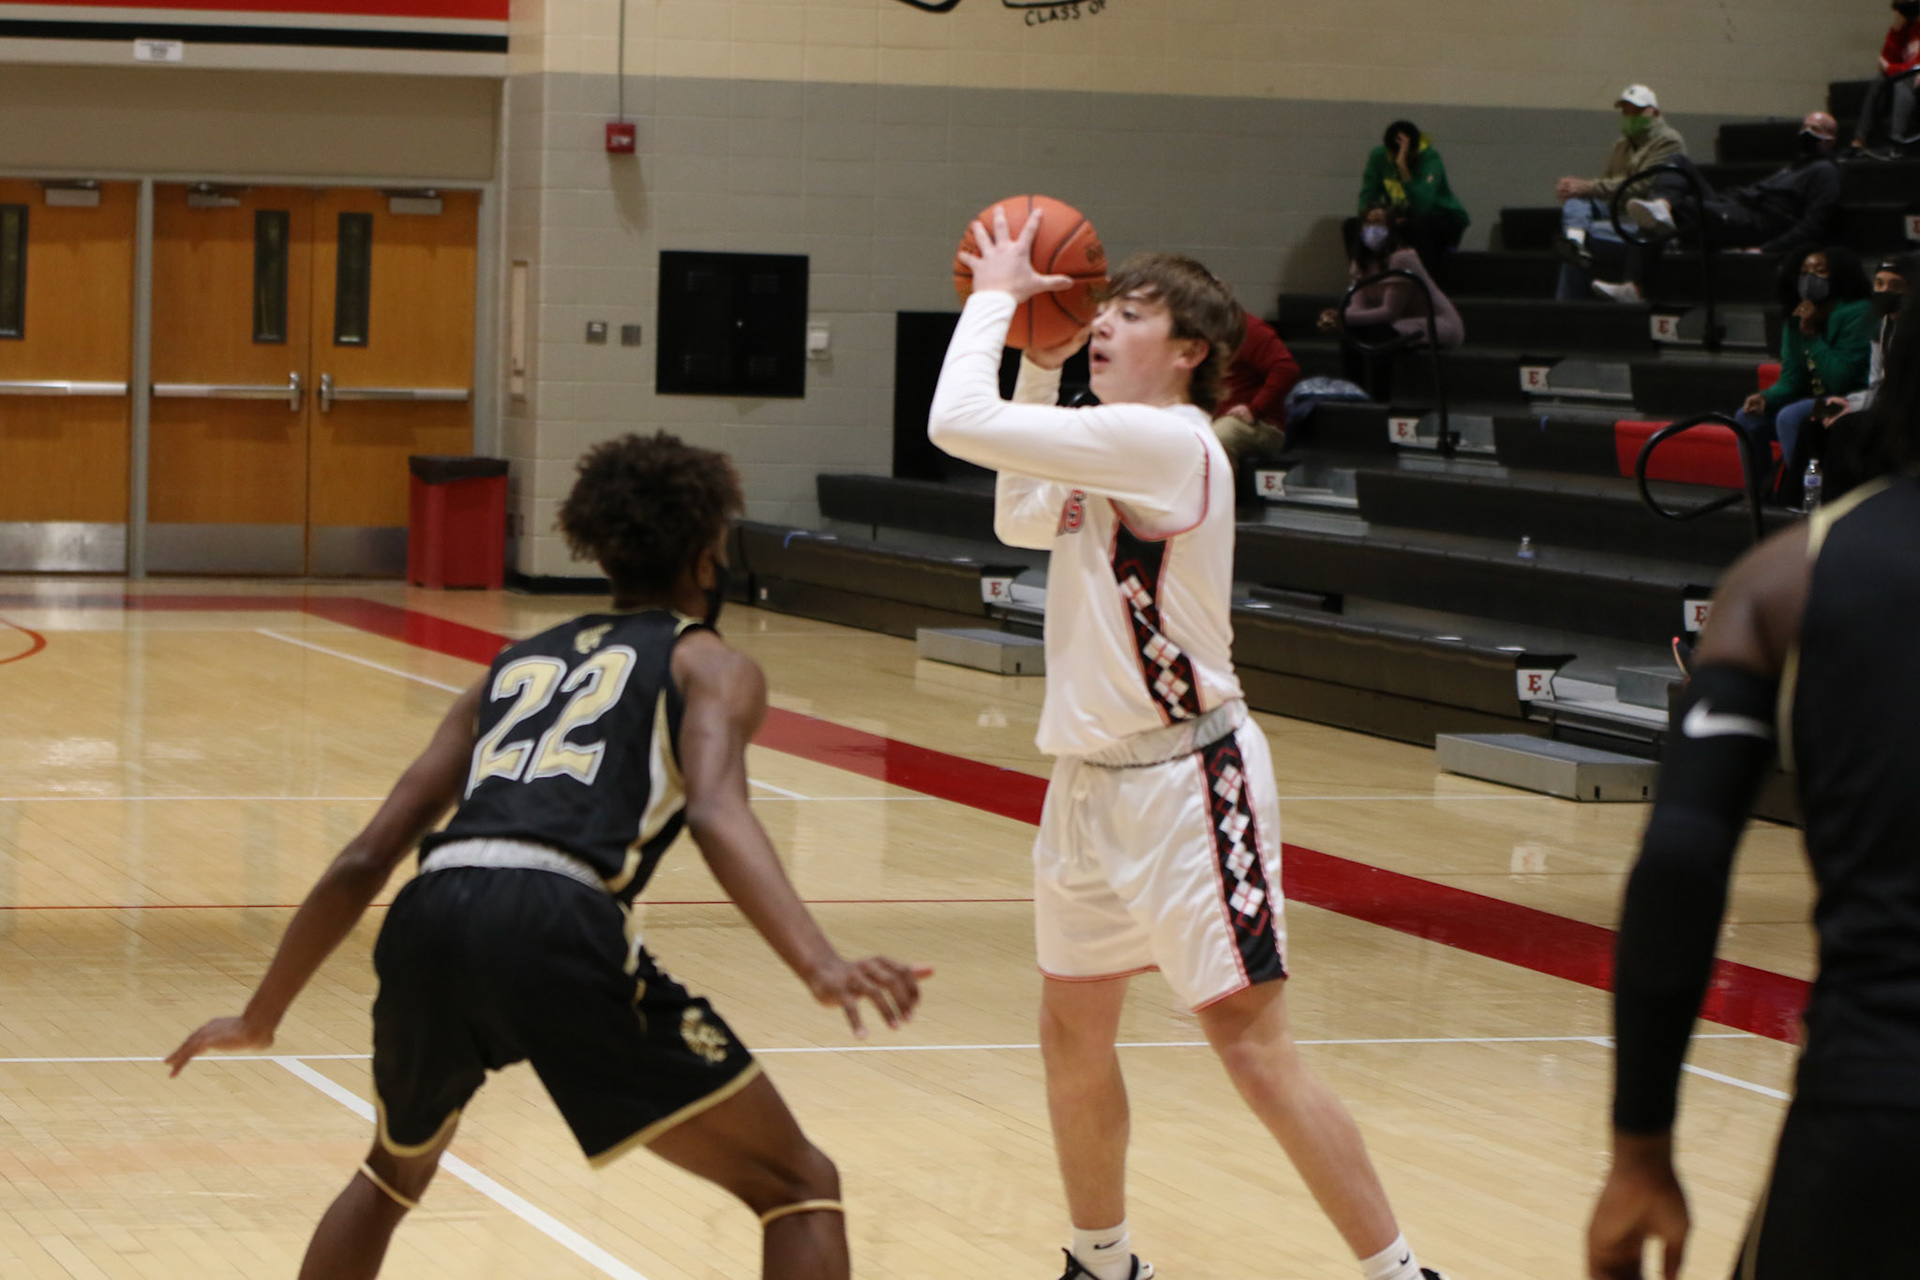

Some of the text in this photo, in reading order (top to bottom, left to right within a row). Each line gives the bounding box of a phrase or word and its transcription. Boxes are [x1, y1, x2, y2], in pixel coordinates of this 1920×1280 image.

[1025, 4, 1081, 27] CLASS
[1528, 370, 1539, 385] E
[1397, 422, 1408, 438] E
[1264, 475, 1276, 491] E
[990, 581, 1003, 597] E
[1694, 605, 1708, 625] E
[1527, 674, 1542, 694] E
[464, 644, 638, 800] 22
